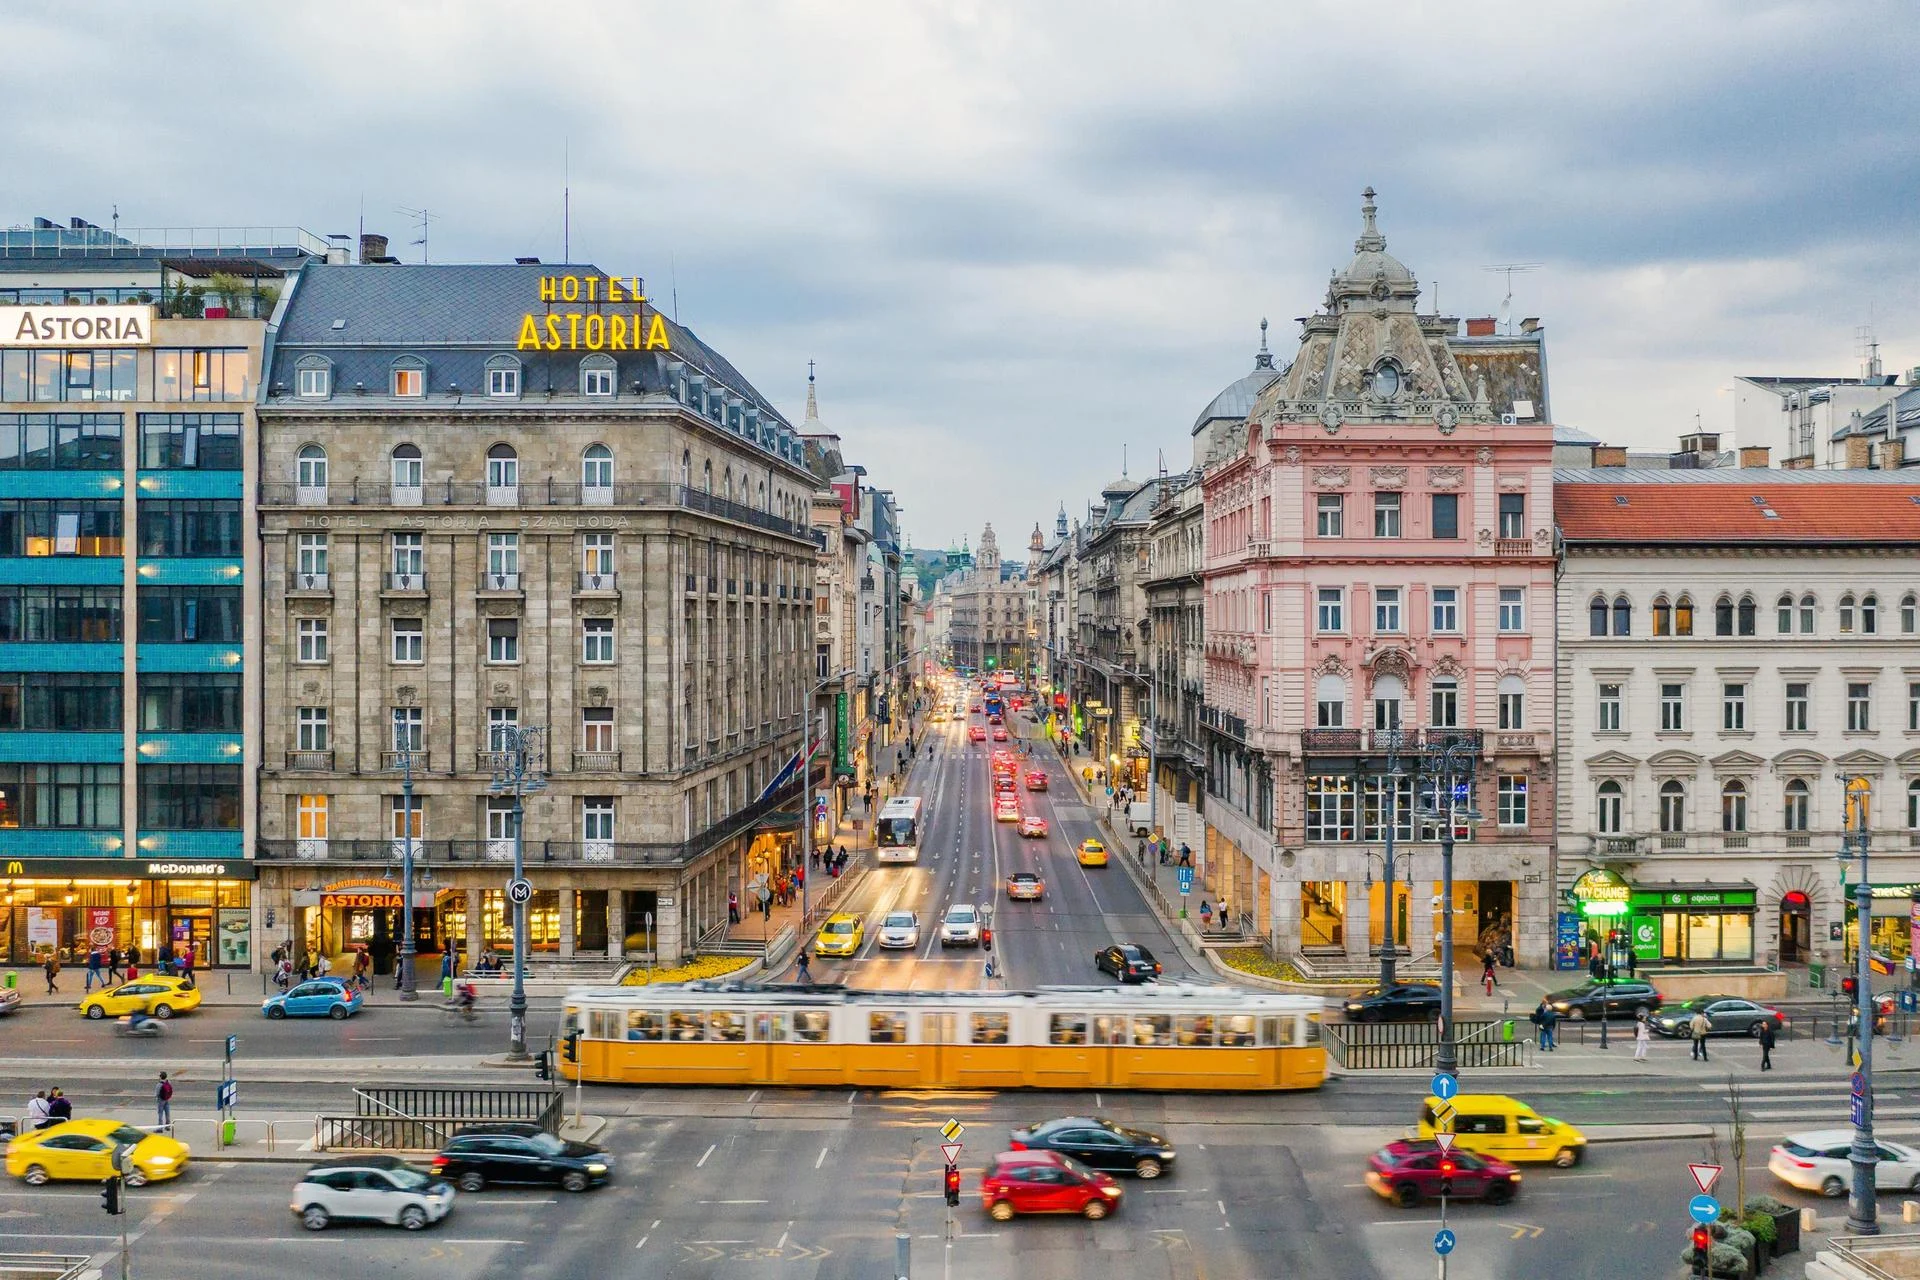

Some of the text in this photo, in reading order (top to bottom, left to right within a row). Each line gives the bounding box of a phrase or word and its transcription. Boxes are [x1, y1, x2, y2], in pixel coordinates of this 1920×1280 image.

[539, 275, 647, 302] HOTEL
[15, 311, 143, 340] ASTORIA
[517, 313, 671, 351] ASTORIA
[304, 515, 371, 527] HOTEL
[399, 515, 490, 527] ASTORIA
[148, 863, 226, 874] McDonald's
[325, 879, 372, 893] DANUBIUS
[1594, 887, 1630, 899] CHANGE
[1691, 894, 1720, 903] otpbank
[323, 895, 404, 907] ASTORIA
